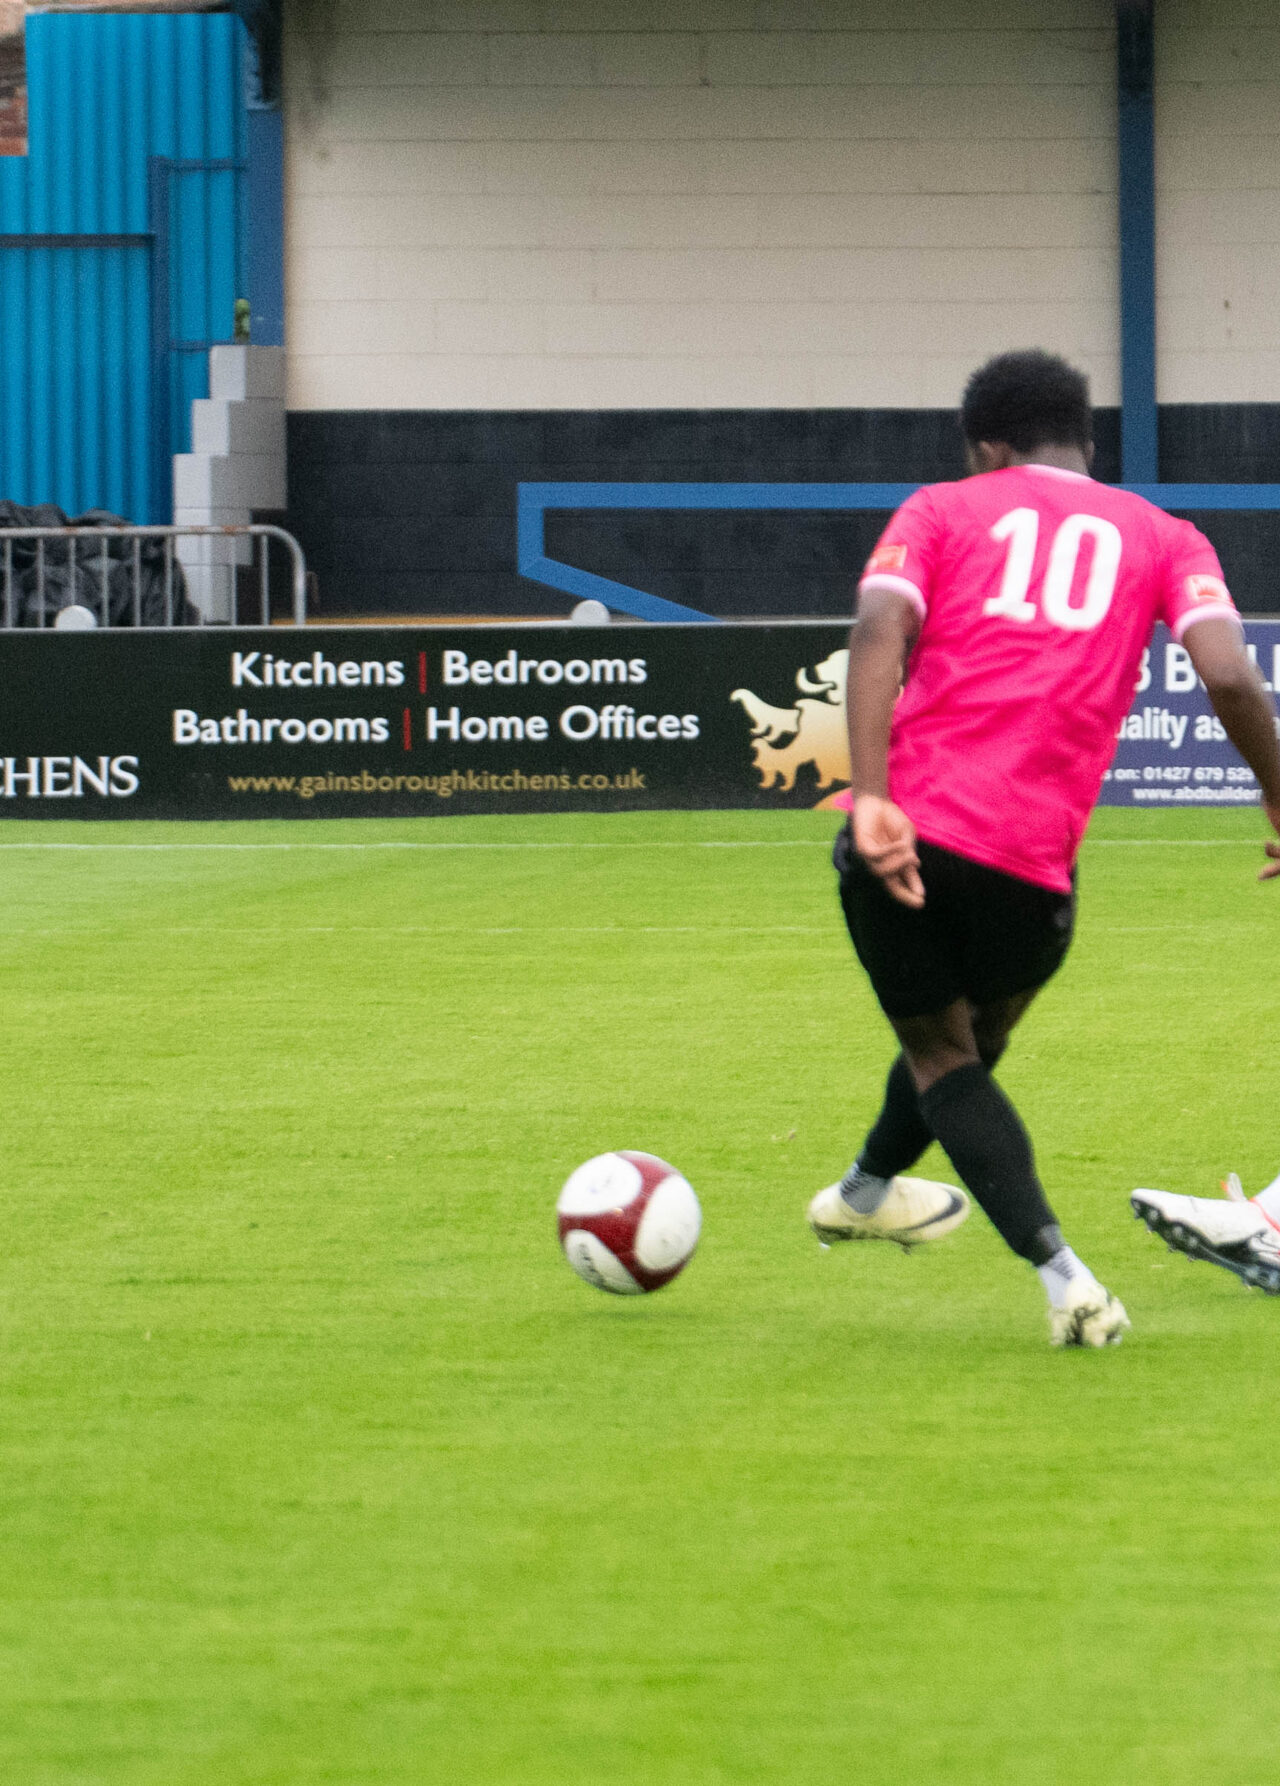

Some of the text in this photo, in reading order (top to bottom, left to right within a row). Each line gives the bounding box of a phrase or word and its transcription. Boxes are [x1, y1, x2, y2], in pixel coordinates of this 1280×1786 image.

[982, 506, 1122, 630] 10
[231, 650, 647, 687] Kitchens Bedrooms
[173, 704, 700, 744] Bathrooms Home Offices
[1115, 707, 1188, 748] uality
[1194, 714, 1228, 741] as
[0, 755, 139, 797] HENS
[228, 768, 647, 799] www.gainsboroughkitchens.co.uk
[1142, 766, 1191, 781] 01427
[1194, 766, 1225, 781] 679
